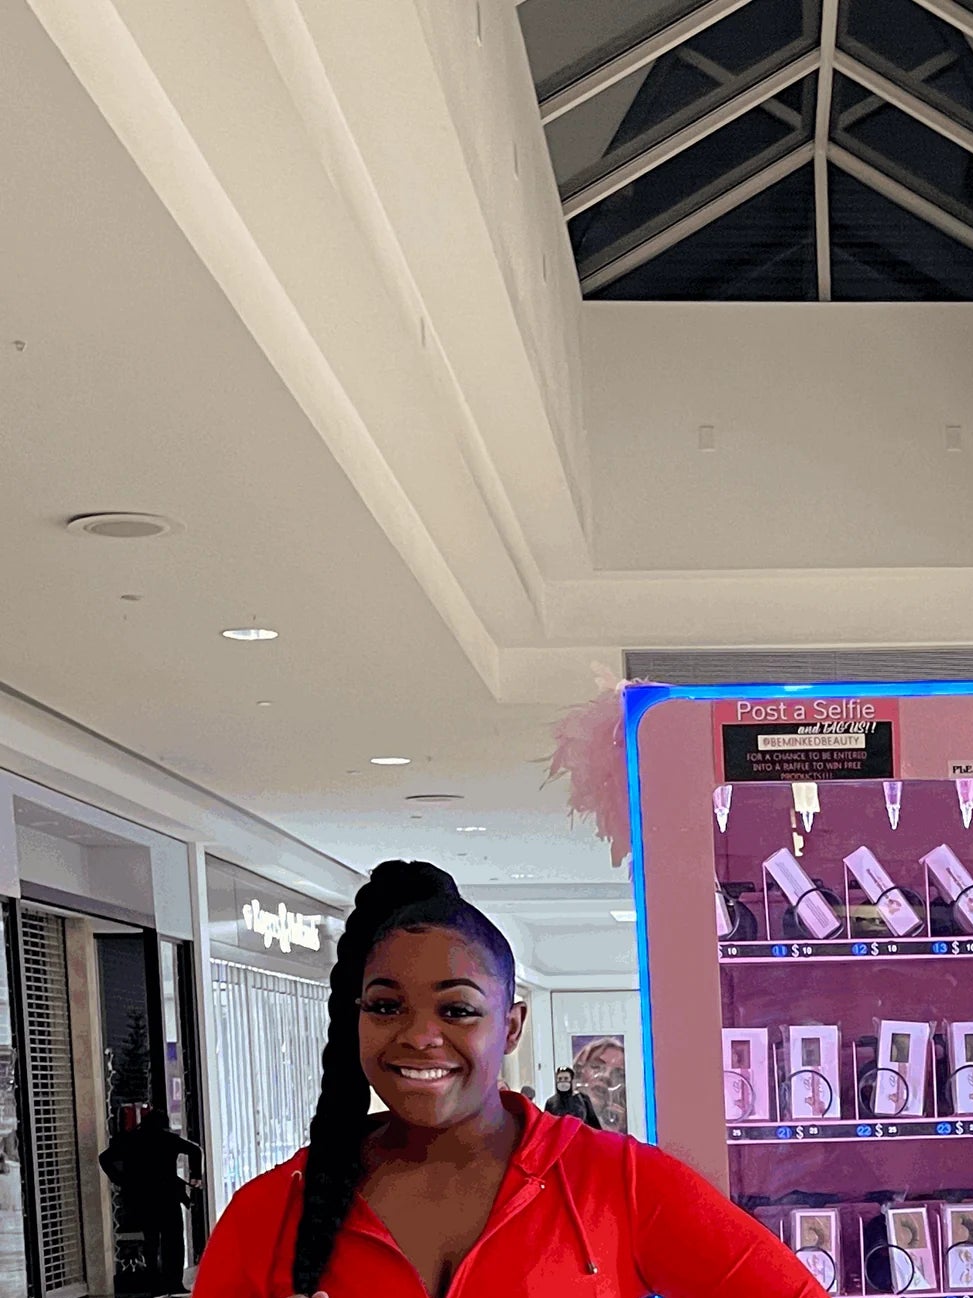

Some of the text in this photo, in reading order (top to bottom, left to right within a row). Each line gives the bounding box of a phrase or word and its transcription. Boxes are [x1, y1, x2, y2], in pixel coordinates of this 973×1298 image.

[737, 699, 875, 721] Post a Selfie
[797, 722, 876, 735] and TAG US!!
[763, 737, 859, 748] @BEMINKEDBEAUTY
[746, 751, 867, 761] FOR A CHANCE TO BE ENTERED
[753, 761, 861, 772] INTO A RAFFLE TO WIN FREE
[727, 947, 737, 955] 10
[791, 944, 799, 958] $
[803, 947, 812, 955] 10
[871, 942, 879, 956] $
[887, 944, 897, 953] 10
[952, 940, 960, 955] $
